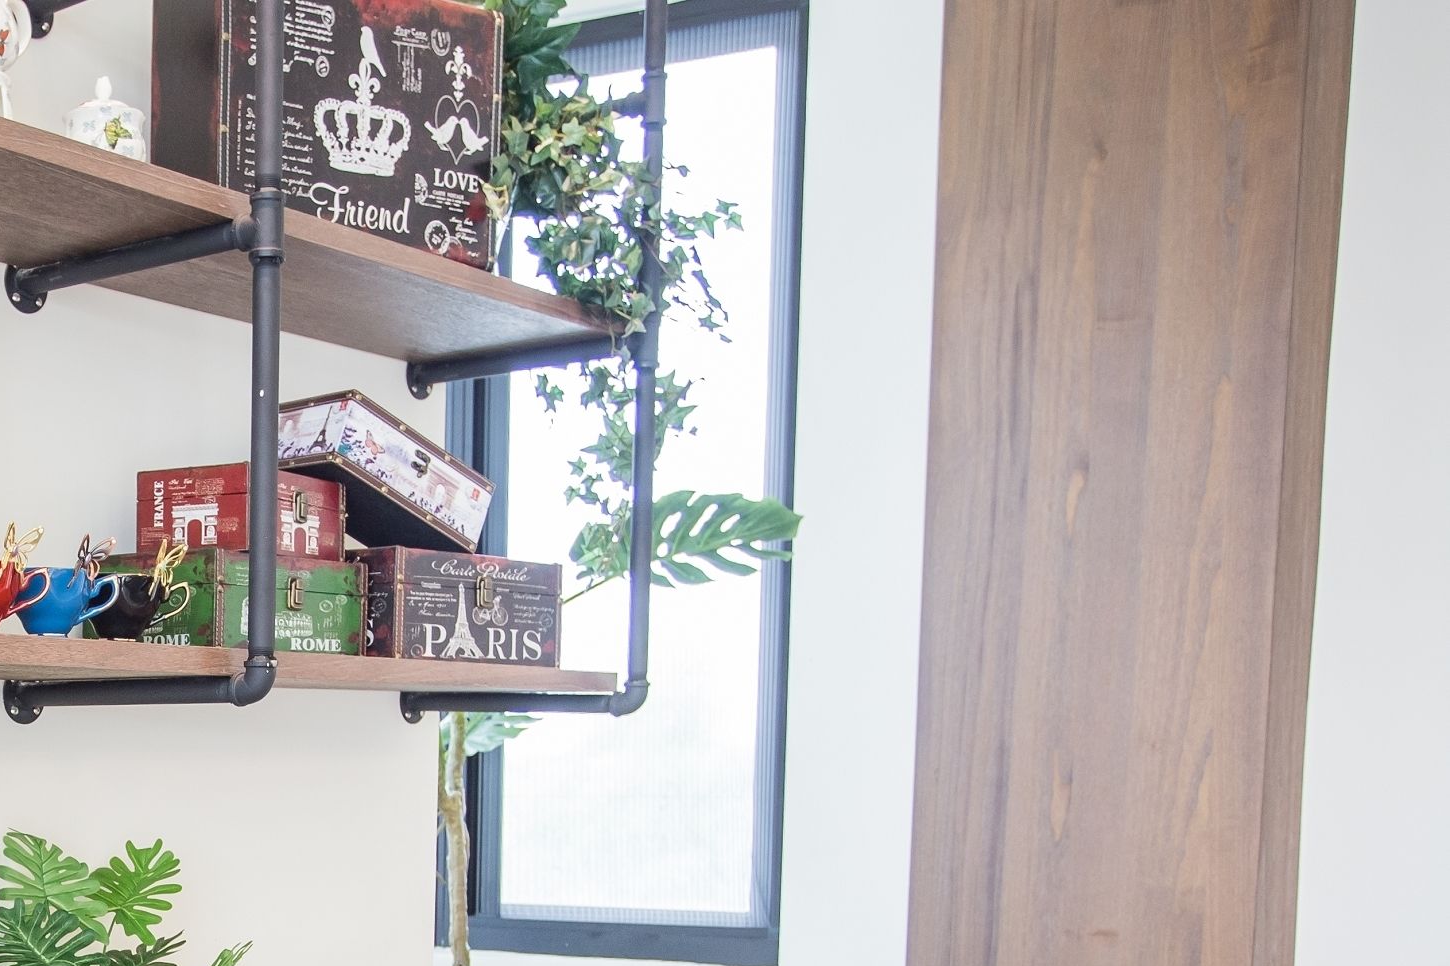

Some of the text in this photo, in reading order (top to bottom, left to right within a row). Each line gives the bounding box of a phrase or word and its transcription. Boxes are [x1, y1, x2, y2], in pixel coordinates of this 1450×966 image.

[433, 167, 479, 194] LOVE
[310, 182, 410, 234] Friend
[153, 480, 164, 528] FRANCE
[431, 559, 476, 577] Carte
[143, 633, 191, 647] ROME
[290, 637, 342, 652] ROME
